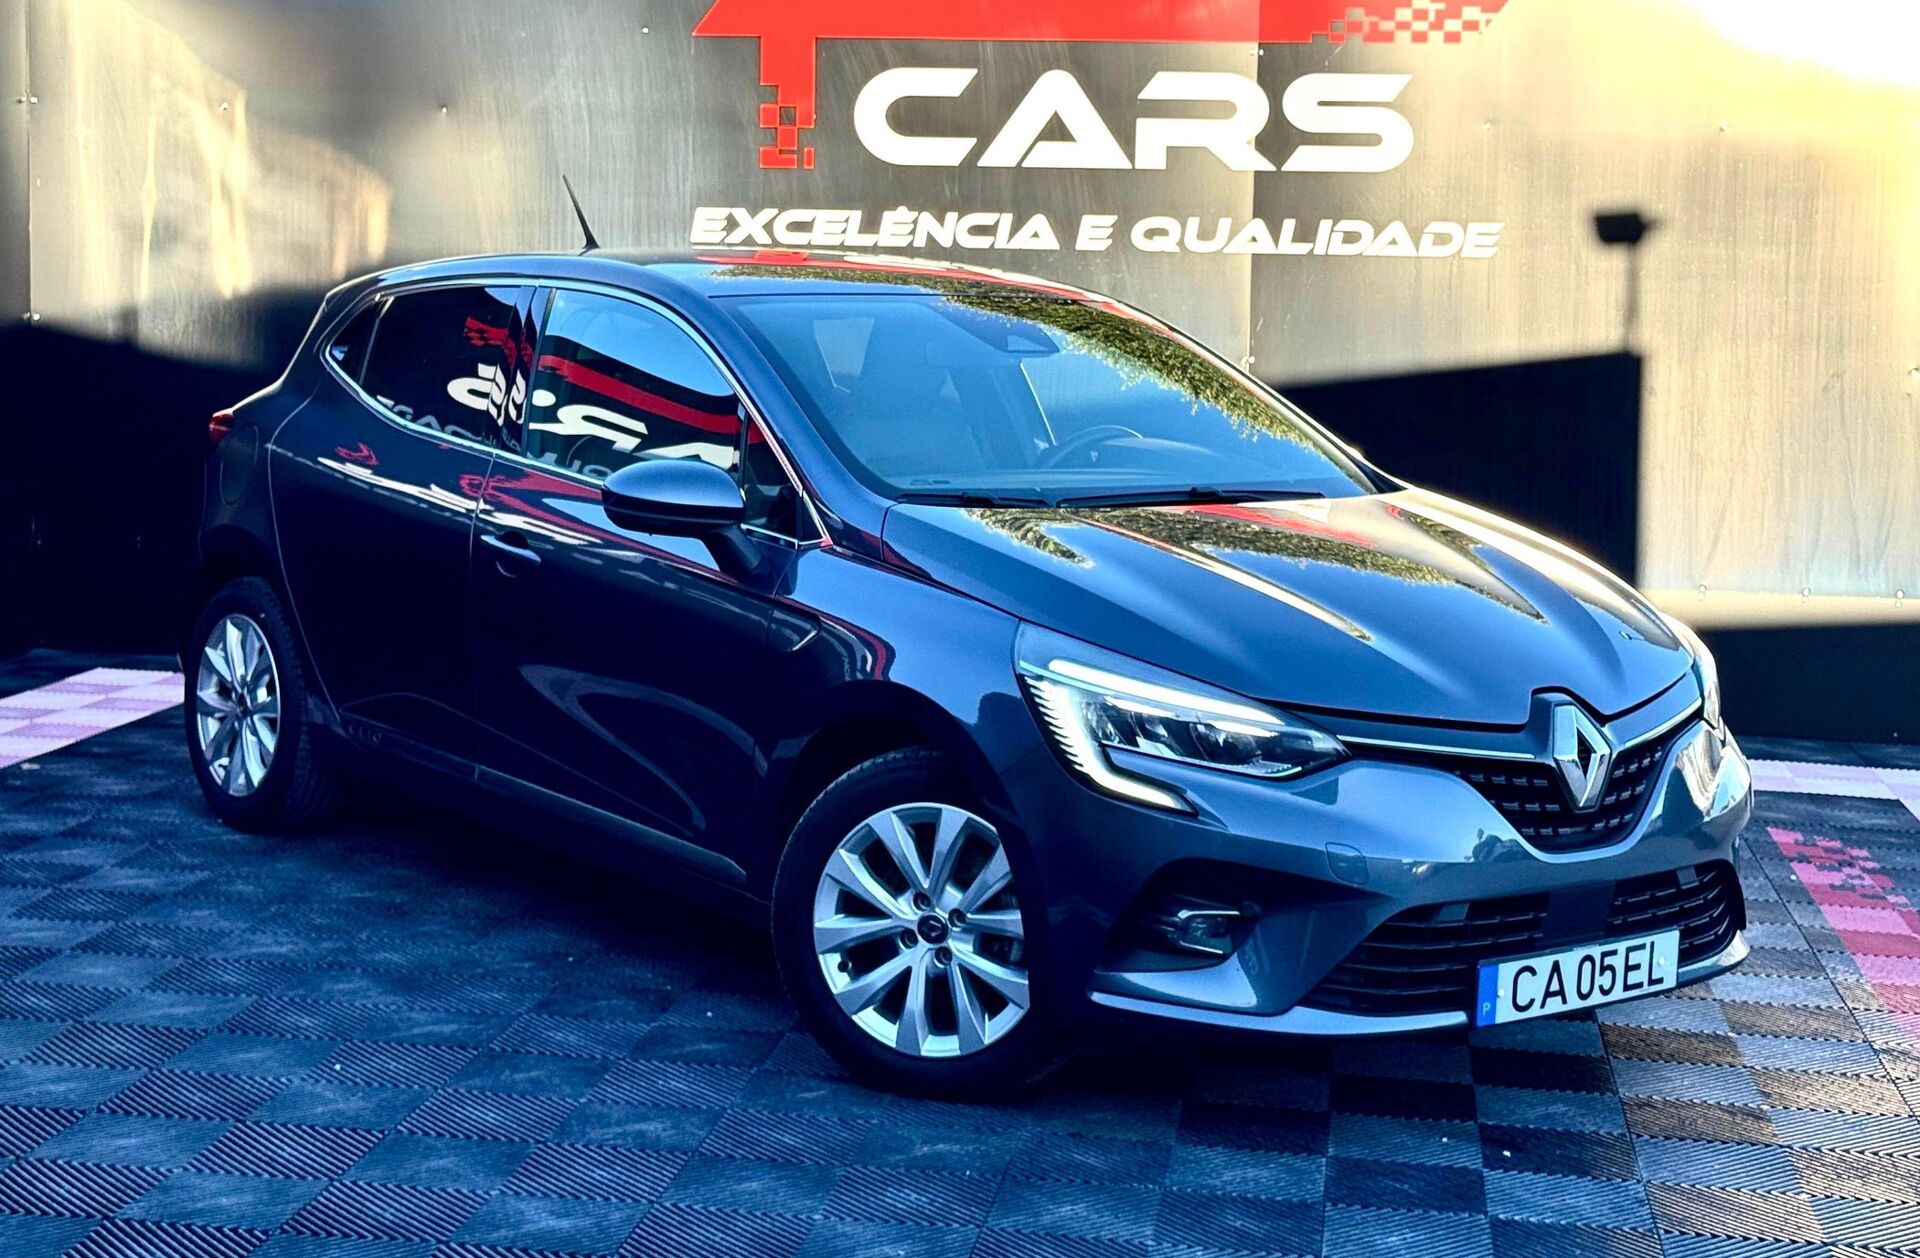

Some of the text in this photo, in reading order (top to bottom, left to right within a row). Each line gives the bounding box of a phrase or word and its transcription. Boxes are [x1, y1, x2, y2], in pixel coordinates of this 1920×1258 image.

[854, 67, 1414, 173] CARS
[689, 205, 1505, 257] EXCELÊNCIA E QUALIDADE
